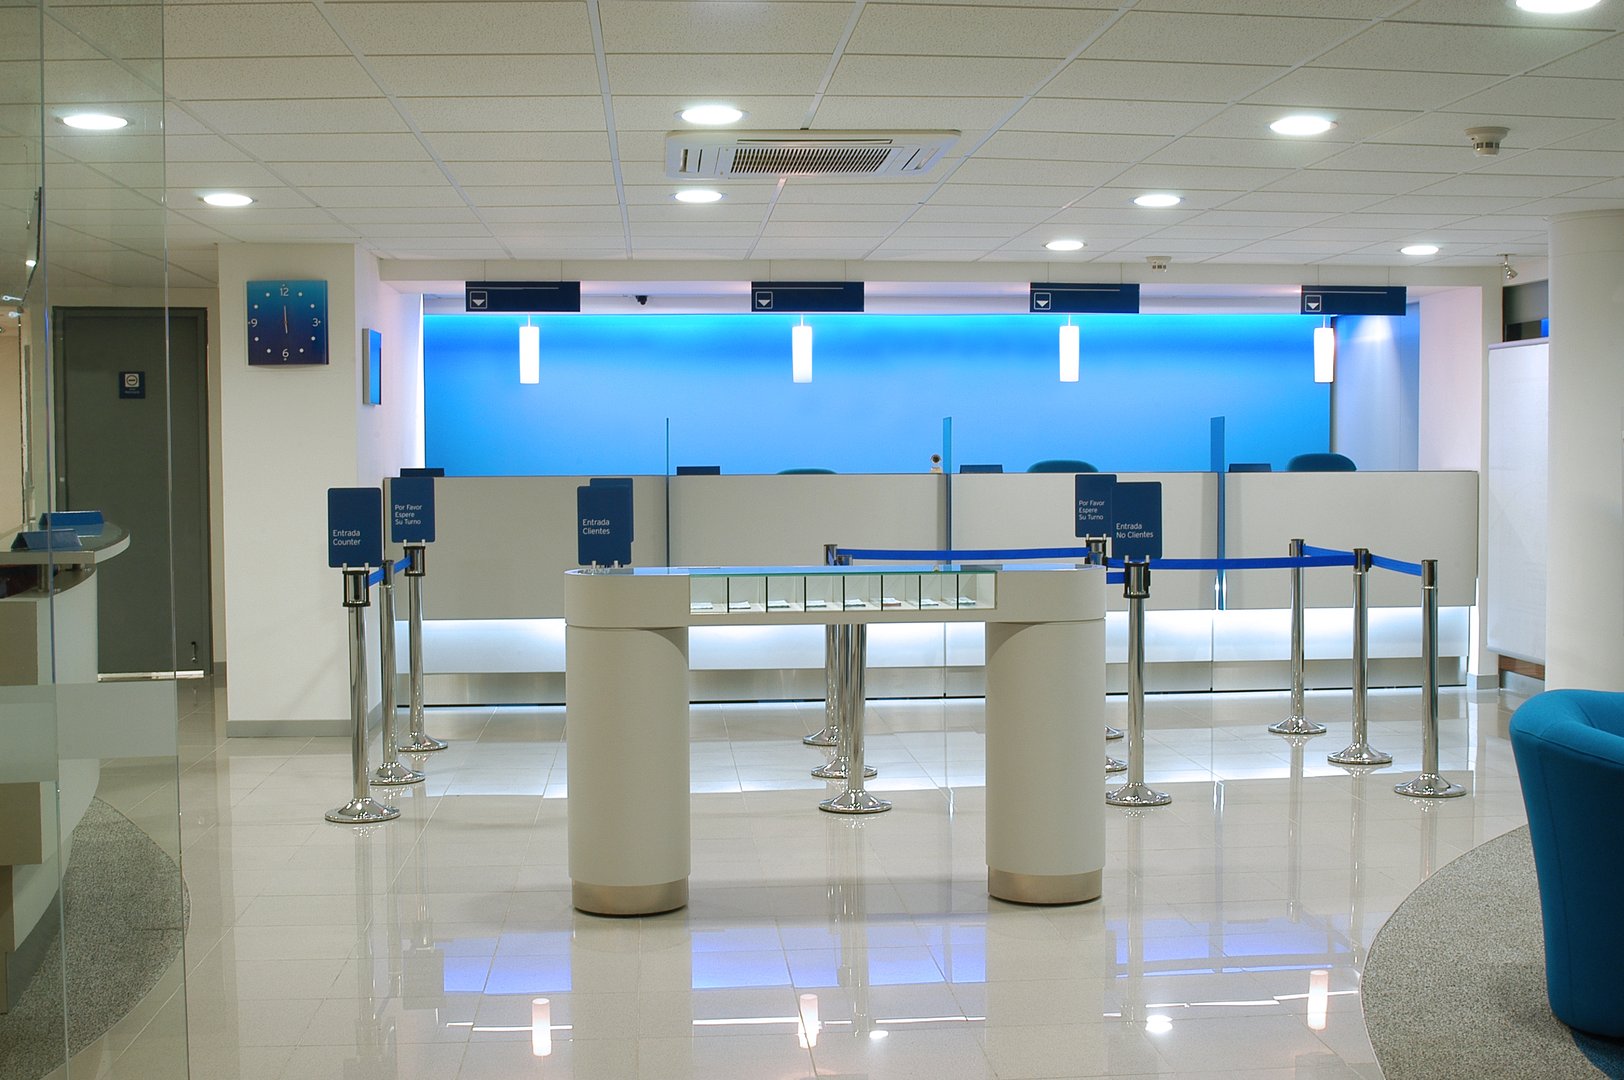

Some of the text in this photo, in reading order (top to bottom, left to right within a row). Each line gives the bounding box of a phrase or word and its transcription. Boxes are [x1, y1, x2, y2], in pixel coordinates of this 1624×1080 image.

[280, 288, 289, 297] 12
[250, 318, 258, 327] 9
[312, 318, 318, 327] 3
[282, 348, 289, 358] 6
